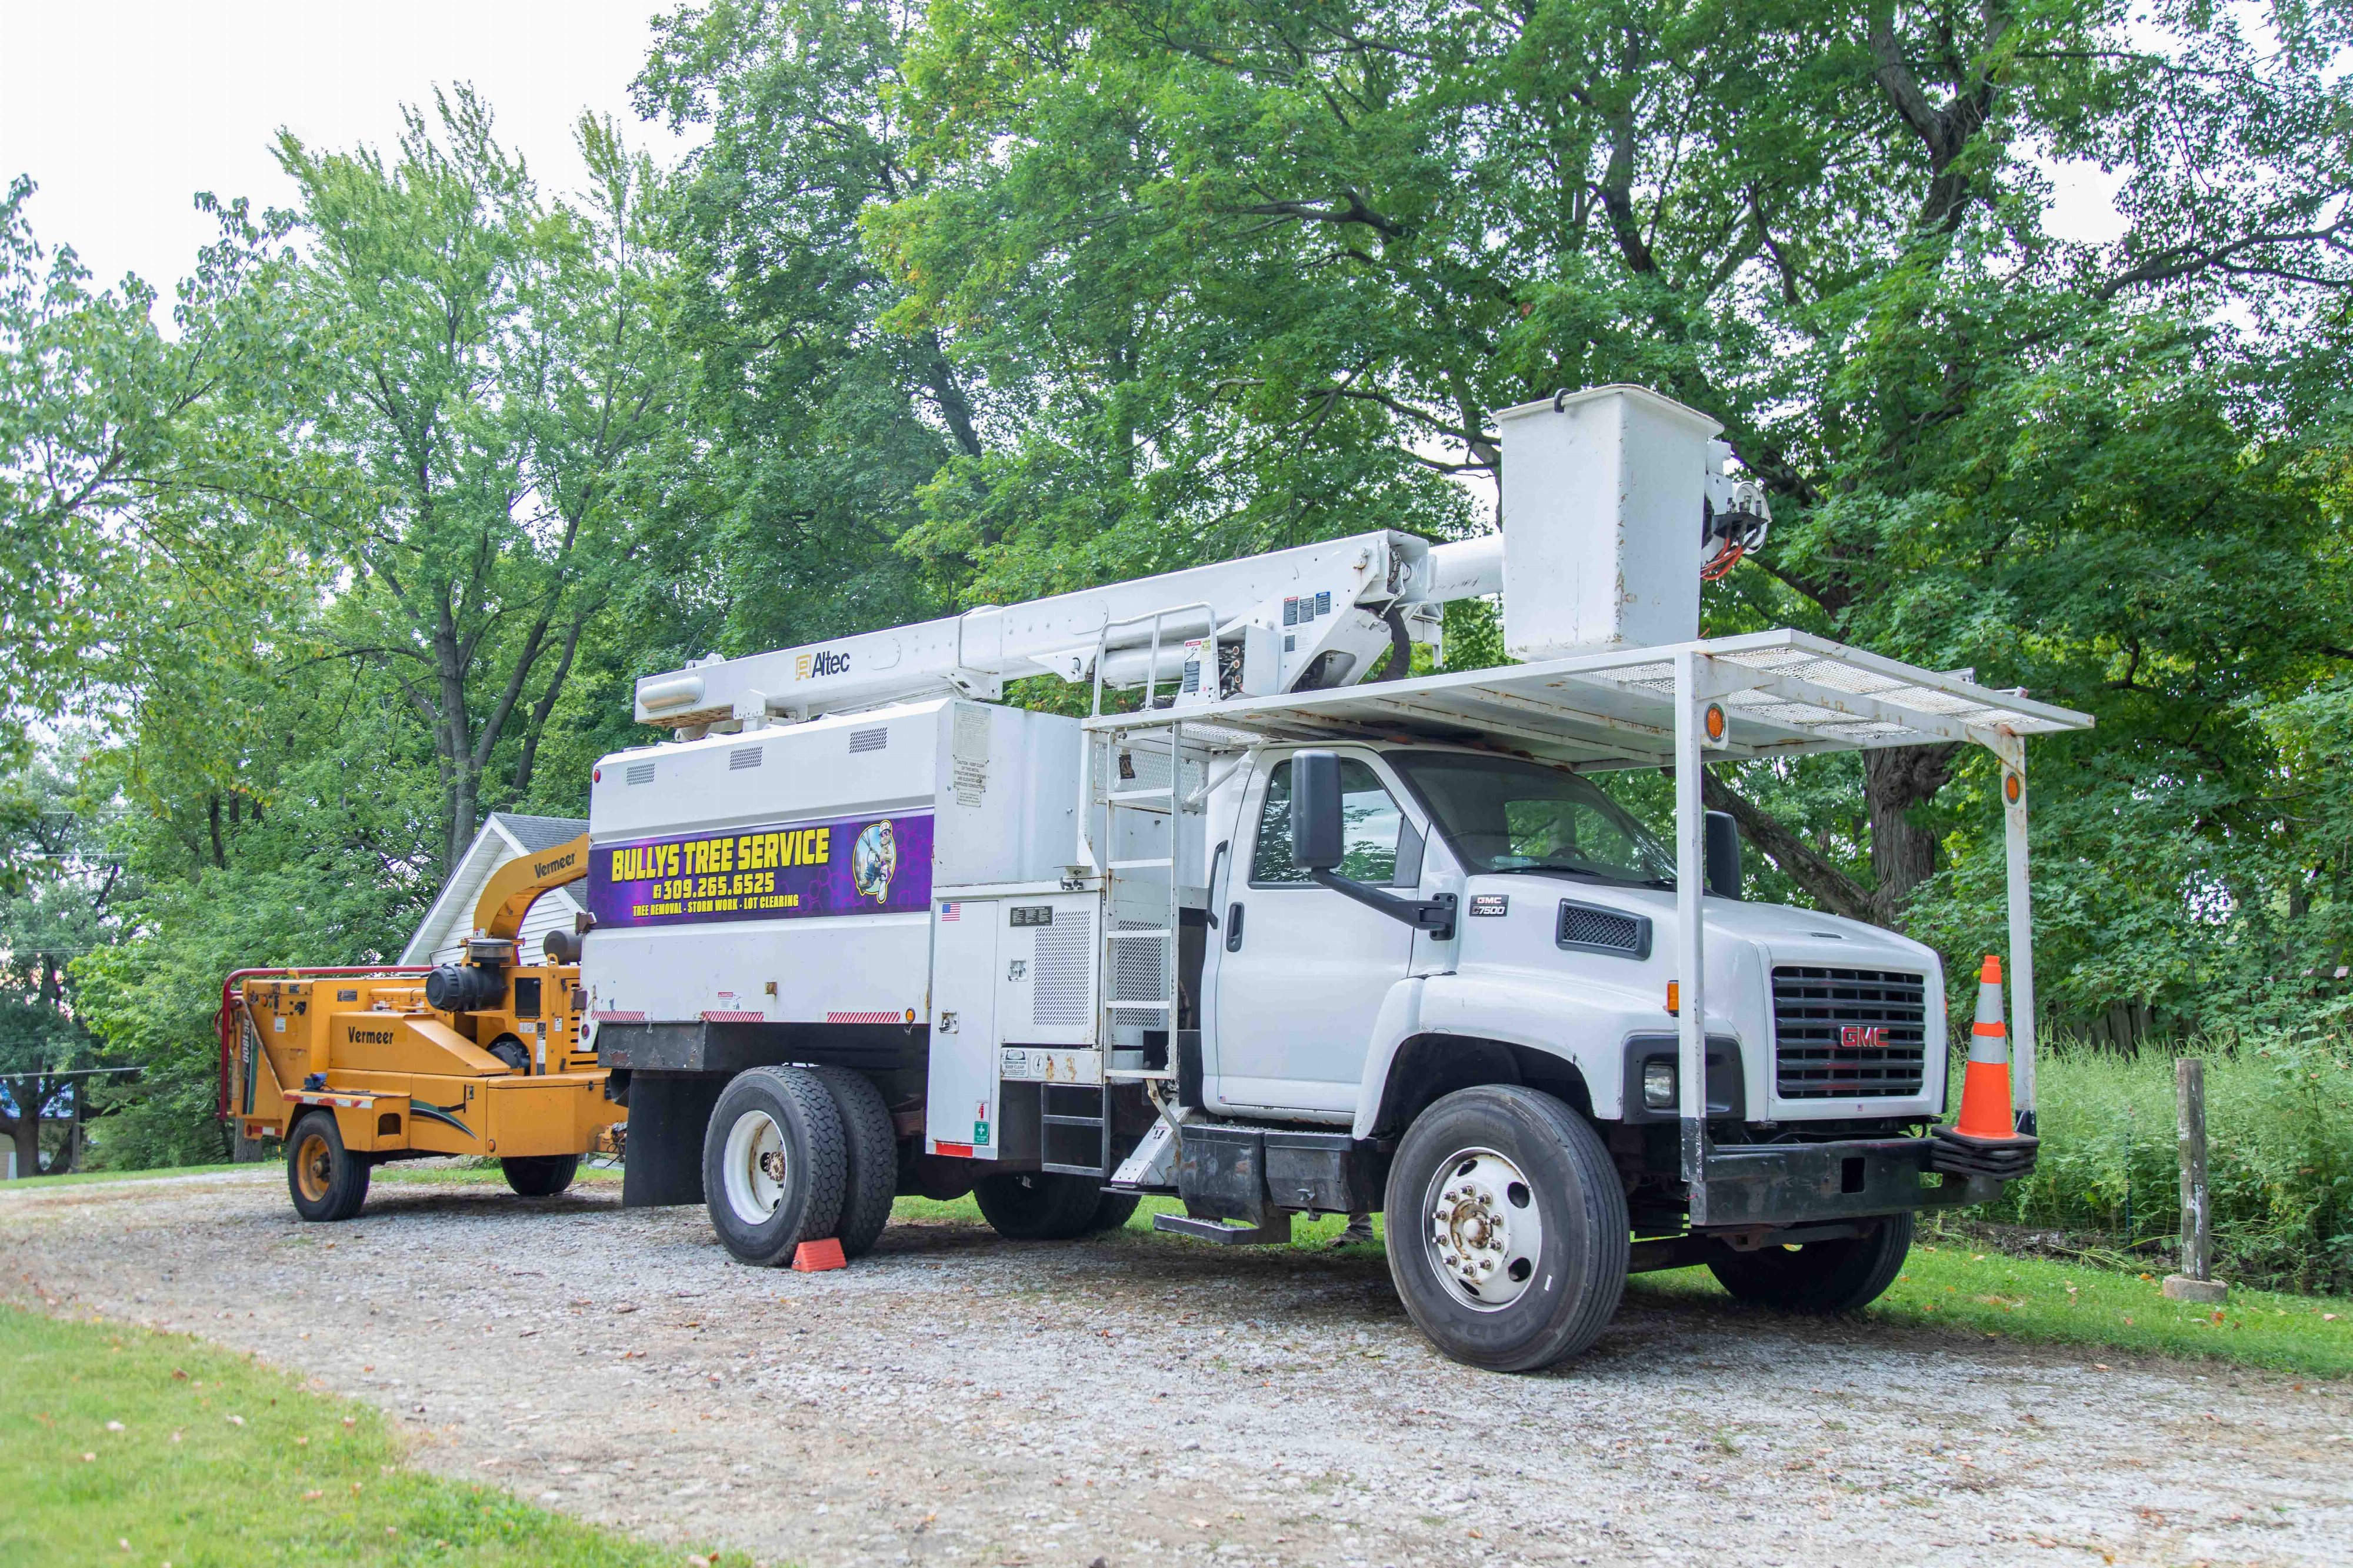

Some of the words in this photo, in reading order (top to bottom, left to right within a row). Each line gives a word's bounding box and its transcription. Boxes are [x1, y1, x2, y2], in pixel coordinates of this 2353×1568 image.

[812, 650, 850, 678] Altec
[534, 853, 575, 878] Vermeer
[611, 844, 679, 882] BULLYS
[684, 838, 734, 875] TREE
[738, 828, 829, 870] SERVICE
[664, 872, 775, 900] 309.265.6525
[633, 905, 649, 917] TREE
[650, 902, 682, 916] REMOVAL
[688, 900, 713, 913] STORM
[715, 898, 738, 911] WORK
[744, 897, 758, 910] LOT
[759, 894, 799, 909] CLEARING
[1471, 906, 1505, 914] C7500
[348, 1026, 394, 1044] Vermeer
[1841, 1026, 1889, 1047] GMC
